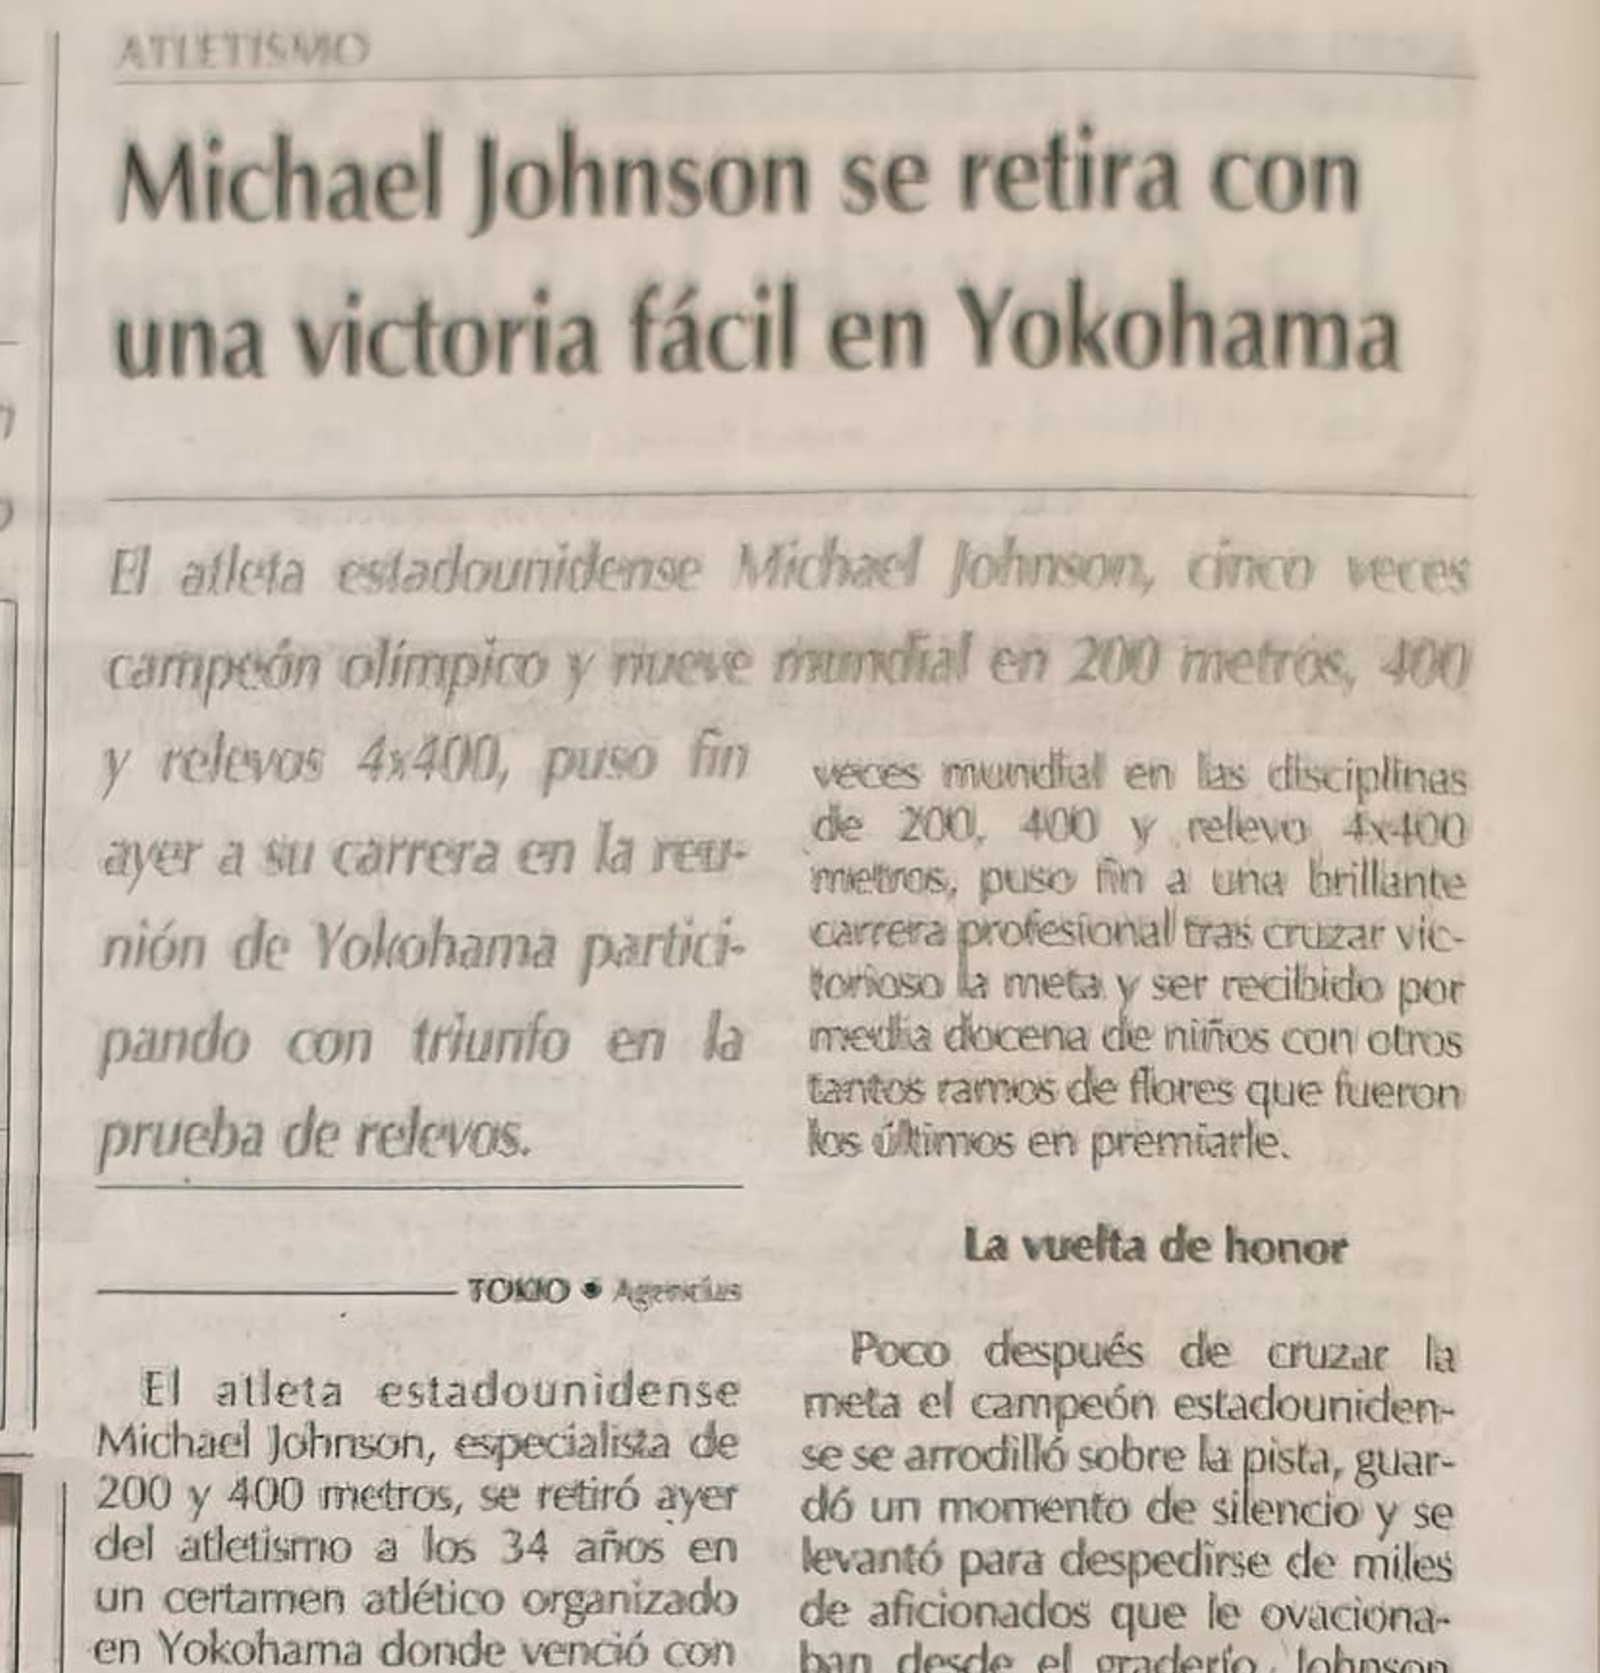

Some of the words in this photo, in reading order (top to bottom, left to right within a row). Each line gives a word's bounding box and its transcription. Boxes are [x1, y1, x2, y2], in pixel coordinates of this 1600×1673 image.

[115, 31, 371, 70] ATLETISMO
[119, 123, 442, 222] Michael
[471, 121, 809, 237] Johnson
[844, 154, 929, 214] se
[961, 123, 1178, 211] retira
[1211, 153, 1358, 212] con
[116, 318, 263, 378] una
[295, 287, 597, 377] victoria
[630, 279, 797, 372] fácil
[828, 309, 925, 370] en
[957, 276, 1398, 370] Yokohama
[102, 748, 131, 800] y
[161, 730, 324, 783] relevos
[357, 733, 508, 790] 4x400,
[542, 744, 658, 798] puso
[690, 726, 749, 779] fin
[102, 919, 206, 970] nión
[232, 917, 289, 970] de
[317, 916, 557, 970] Yokohama
[579, 916, 745, 987] partici-
[97, 1010, 250, 1080] pando
[287, 1028, 372, 1064] con
[413, 1010, 570, 1064] triunfo
[607, 1027, 666, 1063] en
[704, 1008, 744, 1062] la
[97, 1105, 264, 1174] prueba
[284, 1104, 340, 1158] de
[356, 1105, 530, 1158] relevos.
[965, 1226, 1008, 1261] La
[1022, 1223, 1146, 1262] vuelta
[1160, 1223, 1212, 1263] de
[1225, 1224, 1349, 1265] honor
[852, 1330, 951, 1367] Poco
[984, 1328, 1145, 1380] después
[1180, 1329, 1231, 1368] de
[1268, 1342, 1389, 1371] cruzar
[1426, 1334, 1456, 1373] la
[146, 1367, 179, 1406] El
[217, 1368, 341, 1407] atleta
[378, 1368, 740, 1408] estadounidense
[98, 1419, 249, 1458] Michael
[269, 1420, 435, 1466] Johnson,
[454, 1420, 670, 1472] especialista
[689, 1420, 739, 1460] de
[98, 1475, 171, 1510] 200
[188, 1485, 211, 1522] y
[228, 1476, 304, 1511] 400
[323, 1480, 462, 1515] metros,
[481, 1485, 520, 1512] se
[538, 1474, 640, 1511] retiró
[656, 1485, 738, 1523] ayer
[95, 1523, 154, 1561] del
[179, 1524, 352, 1563] atletismo
[376, 1538, 397, 1563] a
[425, 1524, 476, 1564] los
[503, 1528, 548, 1564] 34
[576, 1528, 665, 1564] años
[689, 1537, 737, 1563] en
[802, 1536, 943, 1576] levantó
[960, 1549, 1043, 1588] para
[1060, 1537, 1270, 1589] despedirse
[1286, 1539, 1336, 1579] de
[1354, 1542, 1453, 1582] miles
[94, 1639, 140, 1664] en
[158, 1628, 362, 1666] Yokohama
[379, 1629, 506, 1667] donde
[521, 1630, 649, 1667] venció
[664, 1640, 735, 1668] con
